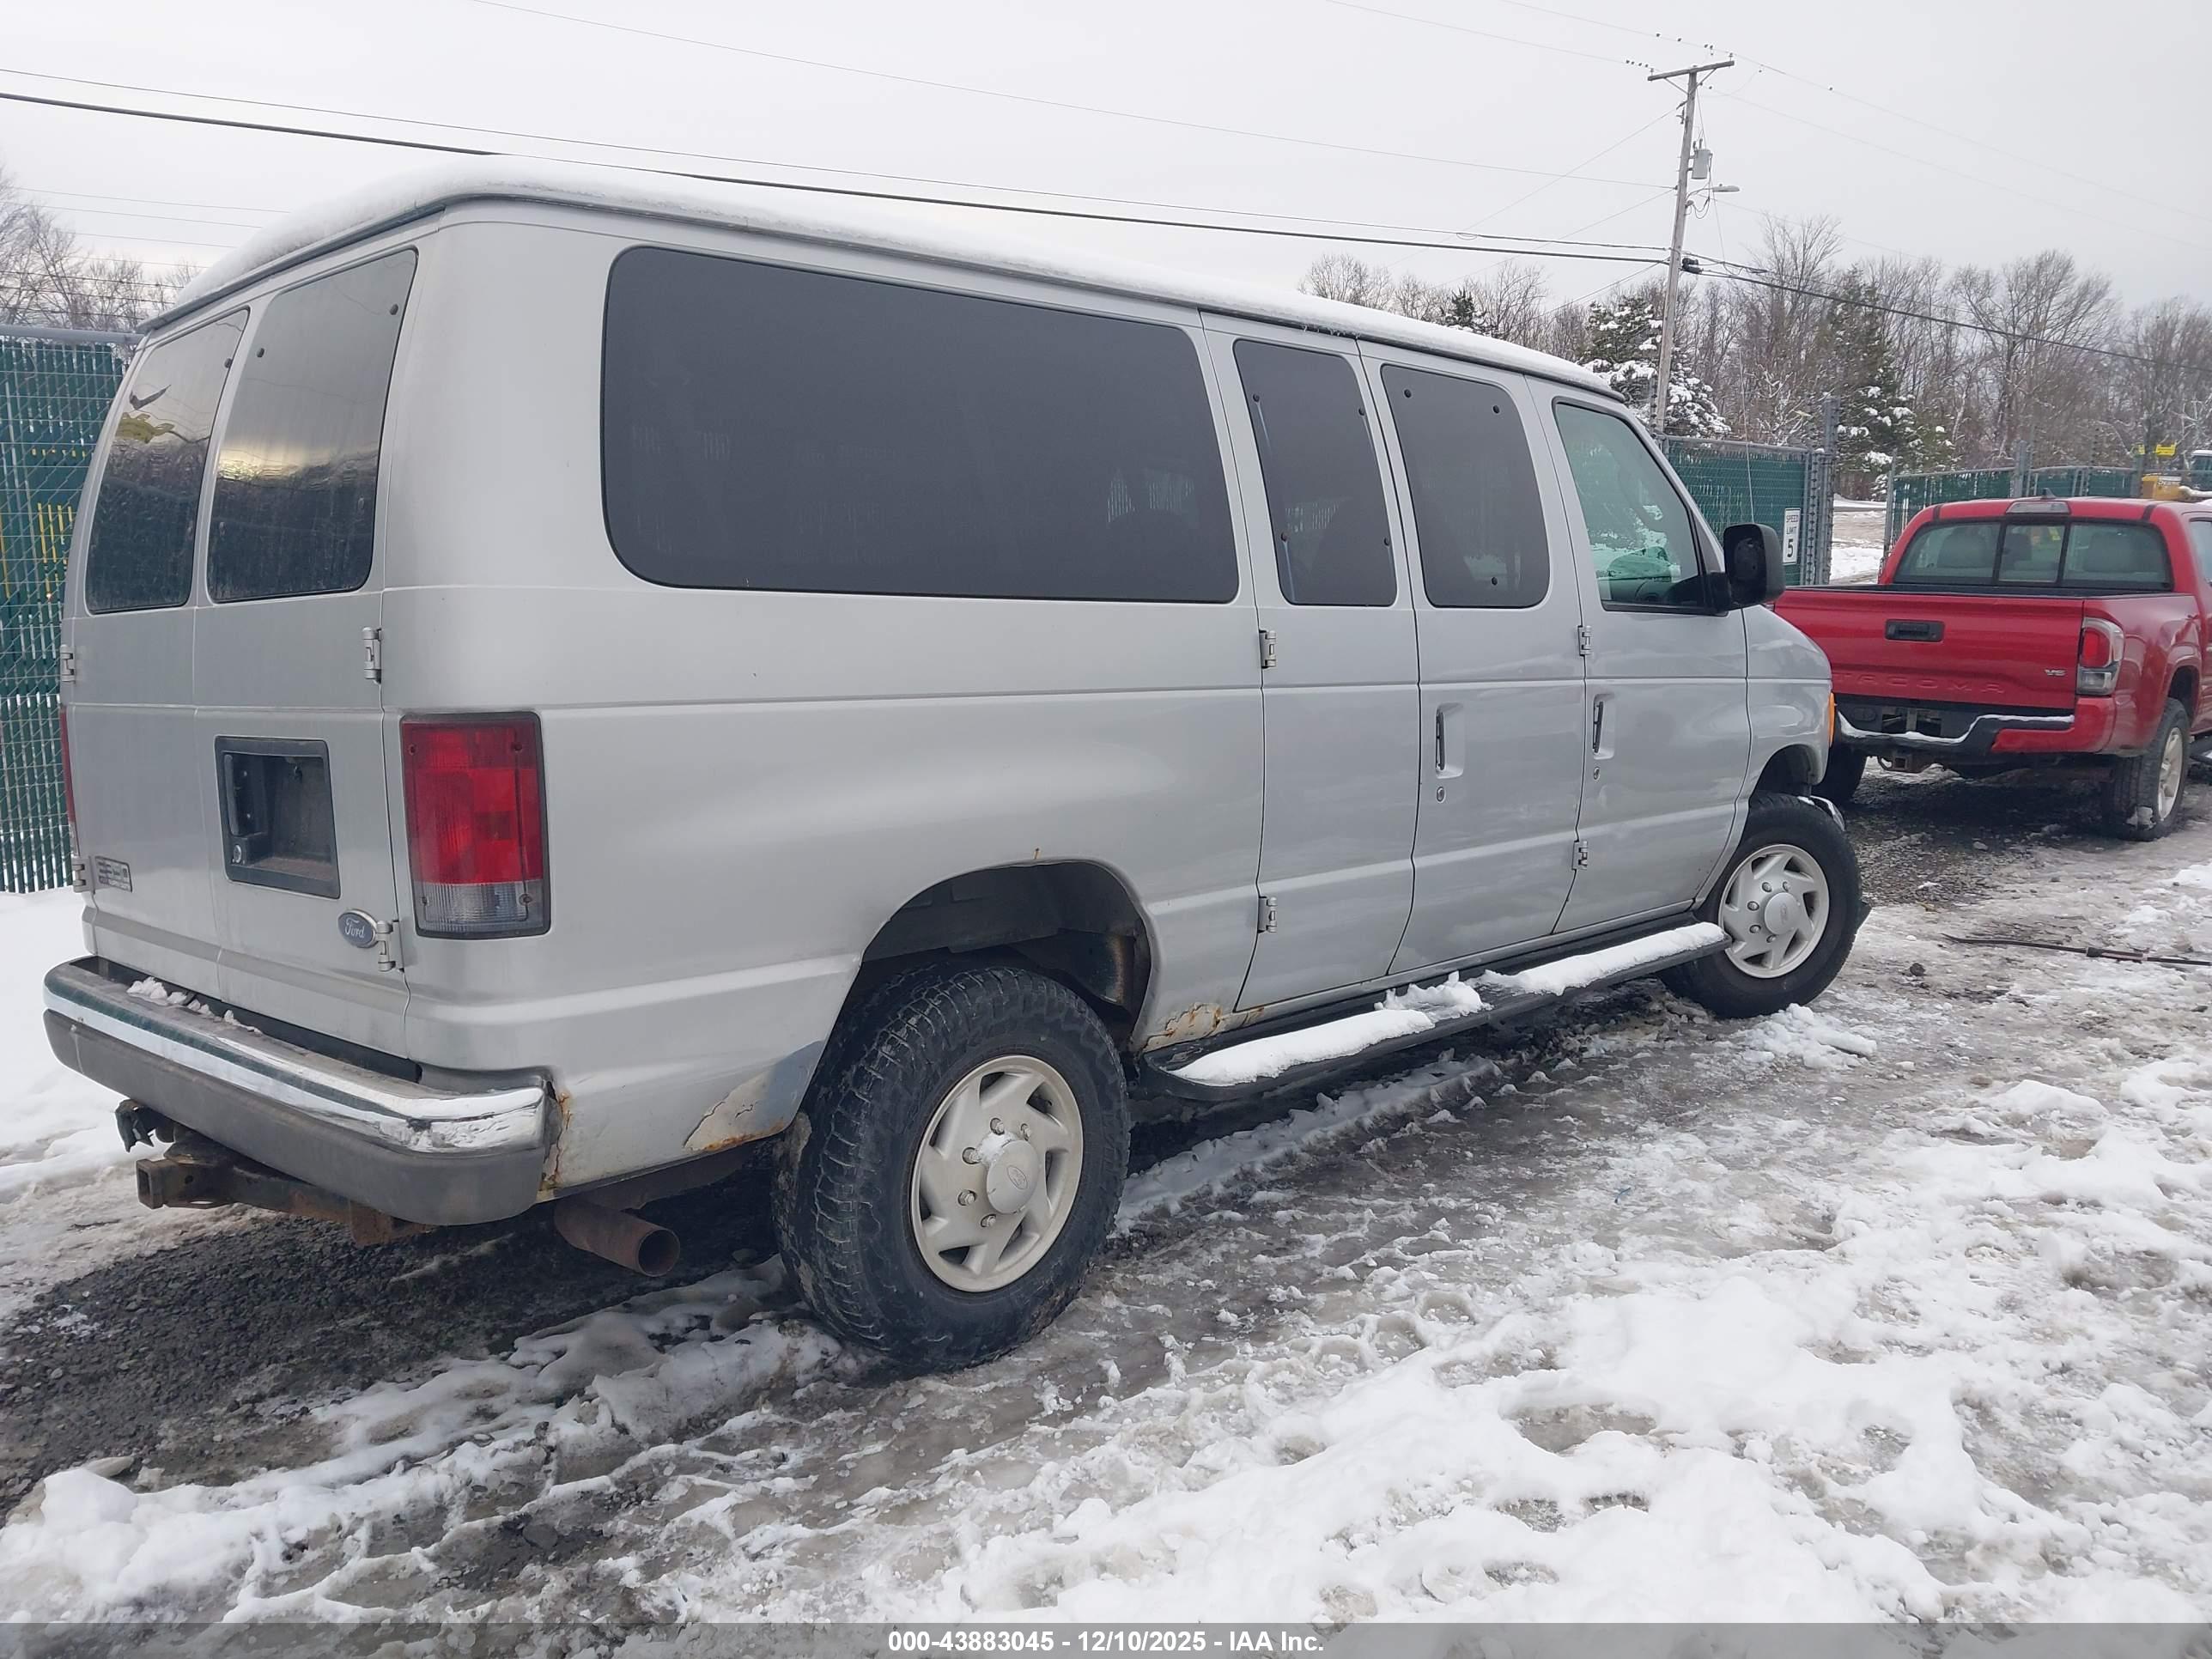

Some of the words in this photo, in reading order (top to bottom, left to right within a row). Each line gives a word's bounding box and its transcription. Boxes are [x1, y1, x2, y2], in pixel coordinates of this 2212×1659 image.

[1785, 514, 1799, 523] SPEED
[1787, 538, 1794, 558] 5
[1832, 672, 2005, 694] TACOMA
[345, 917, 366, 939] Ford
